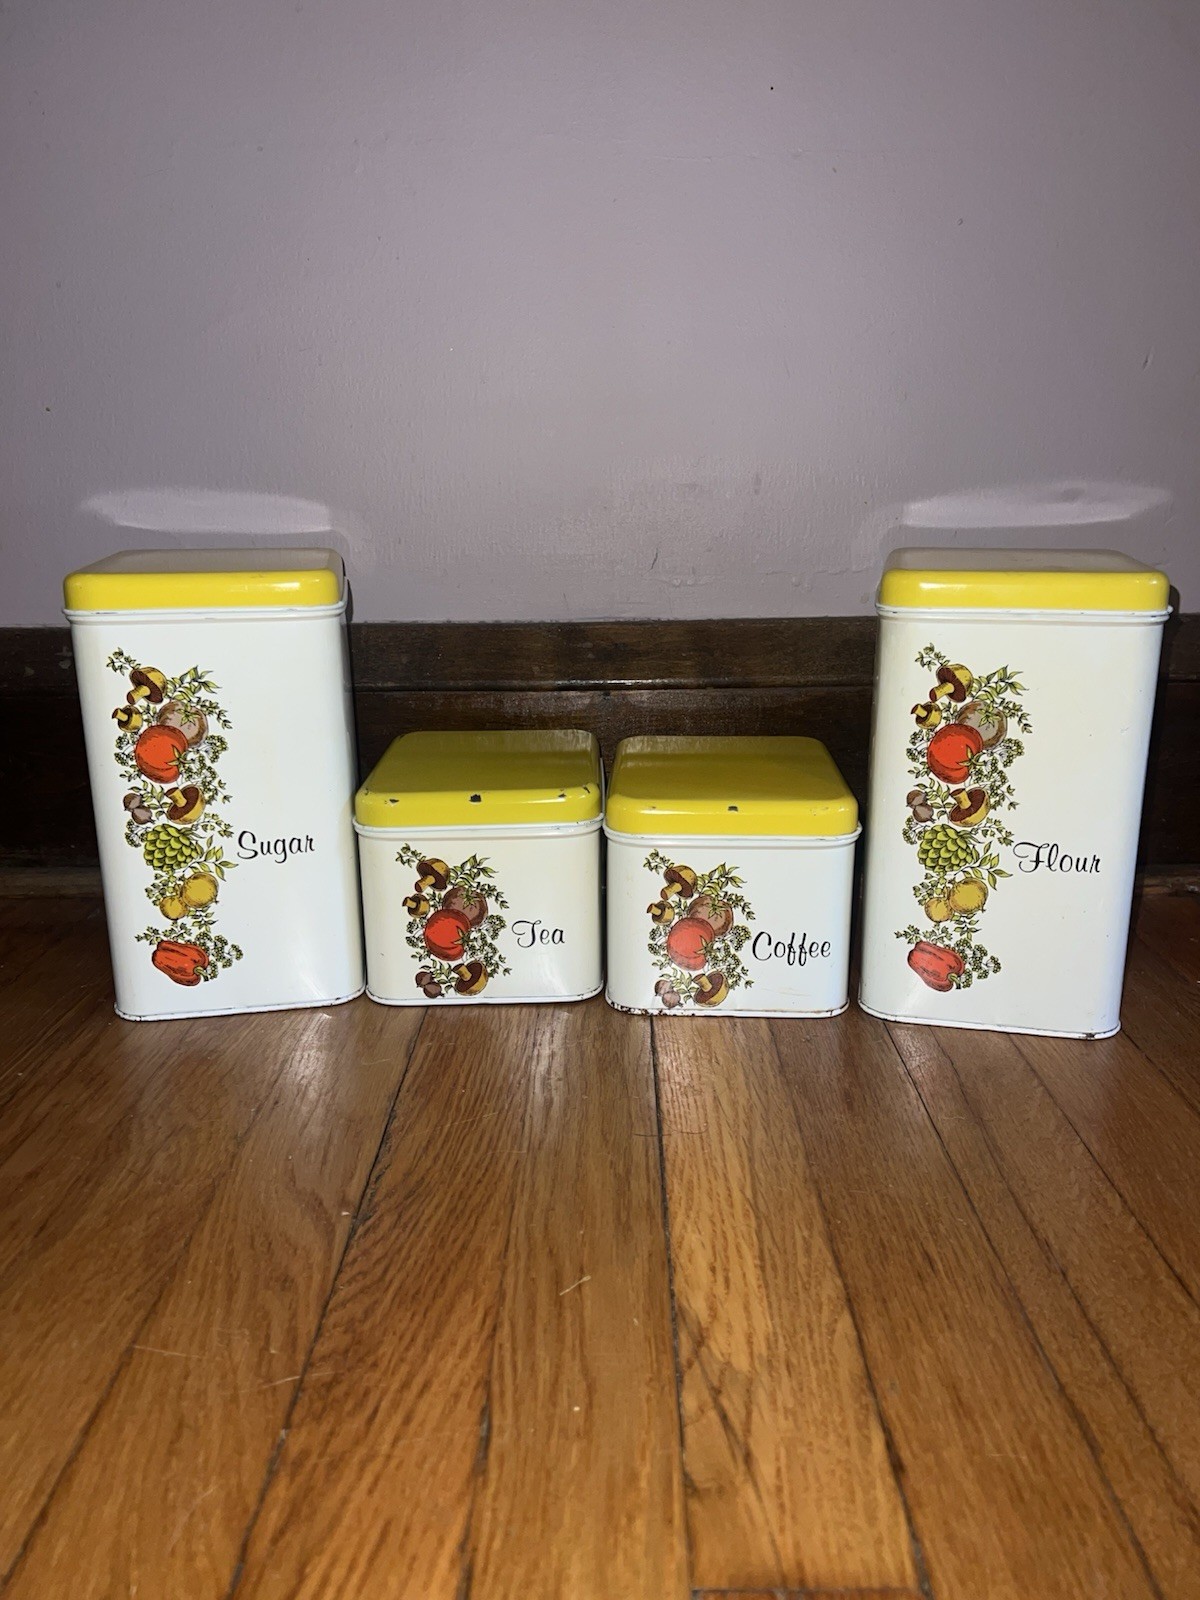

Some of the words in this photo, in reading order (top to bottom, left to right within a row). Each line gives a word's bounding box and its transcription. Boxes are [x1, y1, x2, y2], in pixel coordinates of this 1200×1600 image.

[237, 830, 315, 864] Sugar
[1013, 841, 1101, 874] Flour
[511, 919, 565, 948] Tea
[751, 931, 831, 967] Coffee
